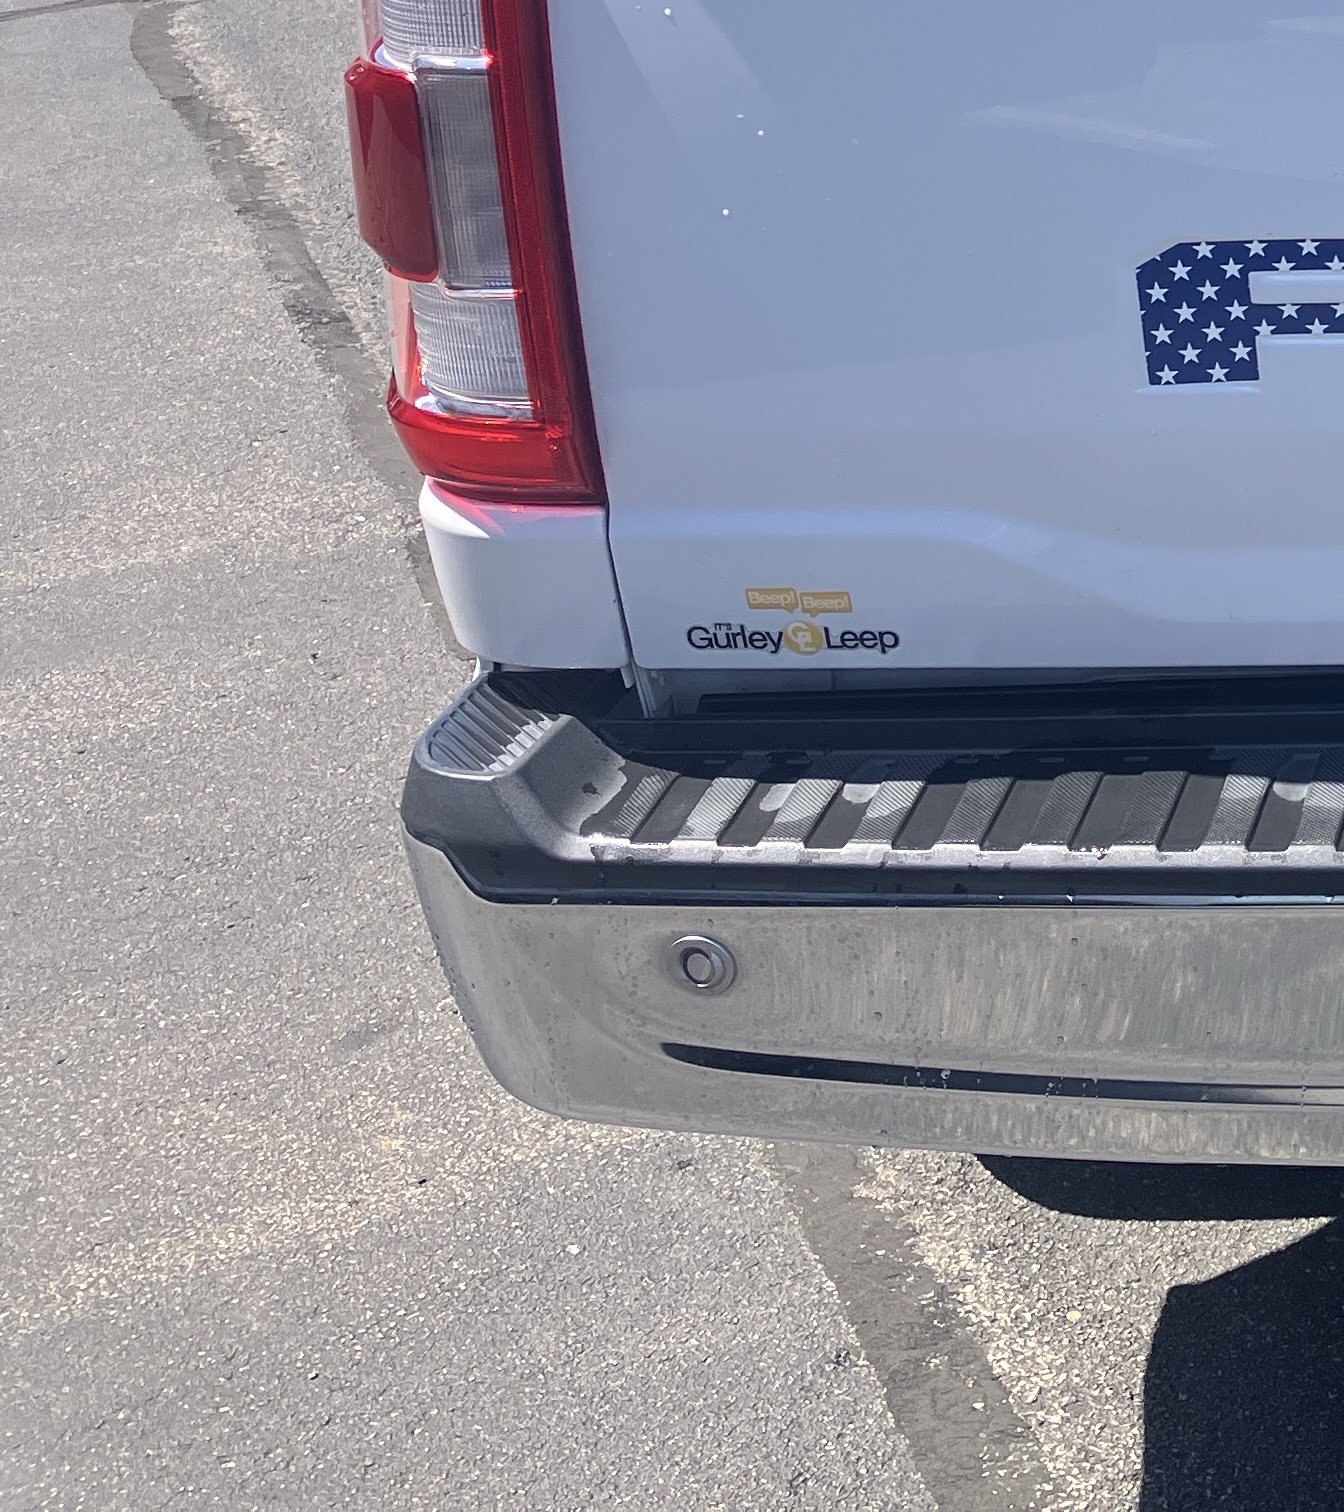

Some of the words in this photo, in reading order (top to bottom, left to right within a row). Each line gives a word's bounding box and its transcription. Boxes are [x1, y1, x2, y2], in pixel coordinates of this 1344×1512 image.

[749, 590, 796, 607] Beep!
[803, 596, 849, 610] Beep!
[687, 624, 784, 654] Gurley
[824, 626, 900, 655] Leep
